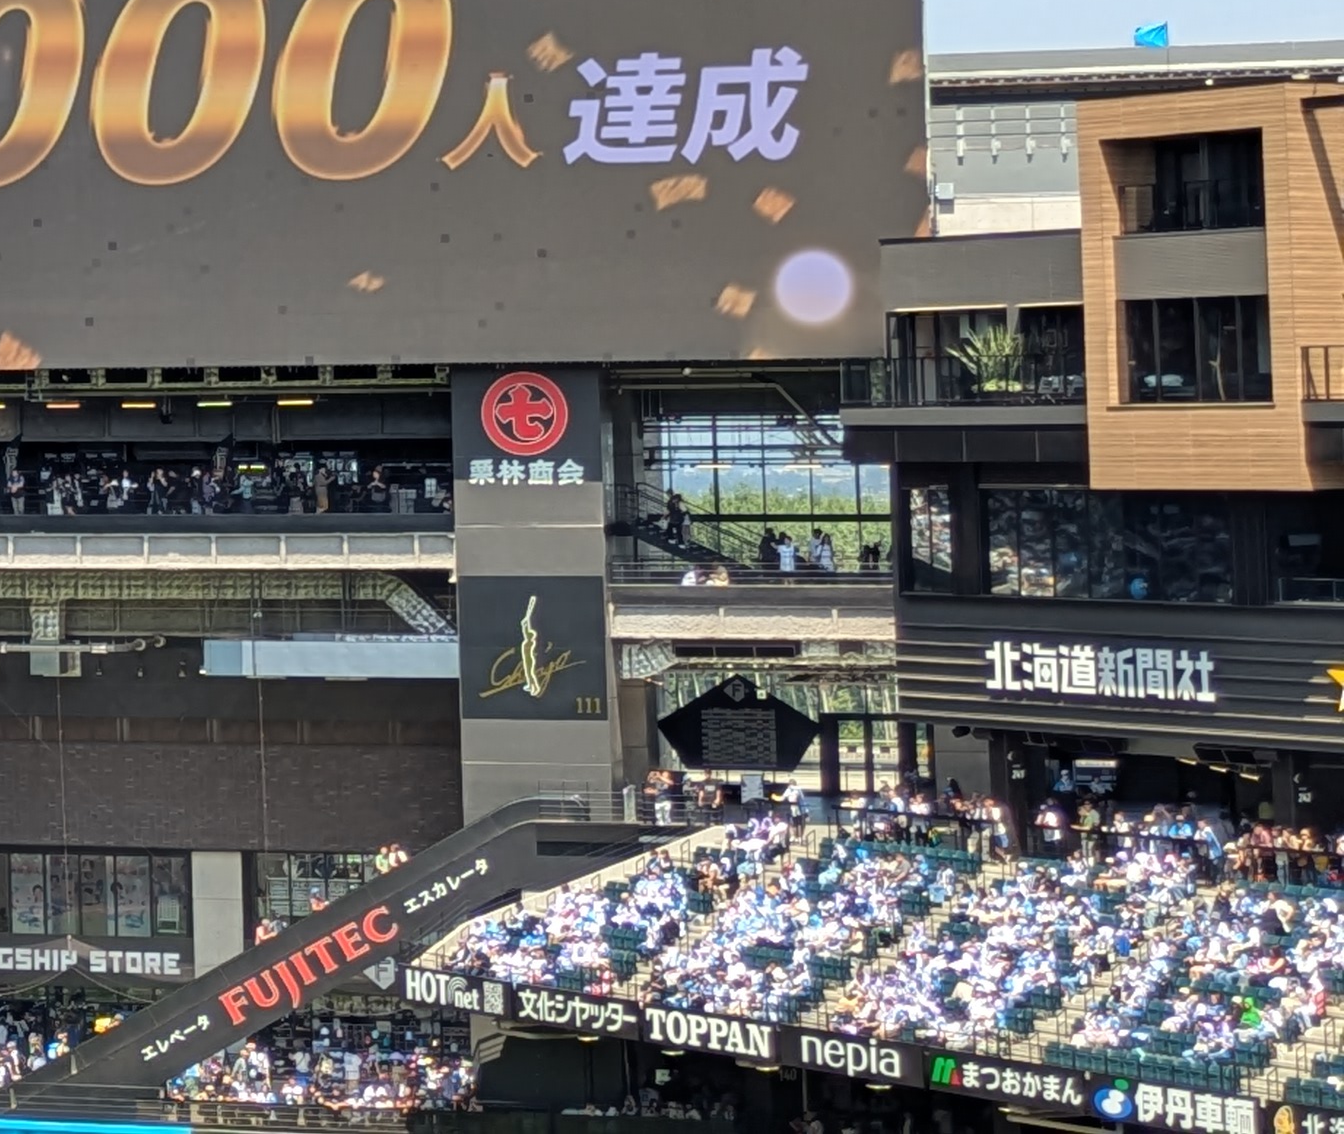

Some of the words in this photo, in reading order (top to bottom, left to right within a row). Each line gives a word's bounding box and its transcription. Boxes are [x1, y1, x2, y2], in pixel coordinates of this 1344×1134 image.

[563, 46, 808, 164] 達成
[468, 459, 585, 486] 栗林商会
[984, 641, 1216, 703] 北海道新聞社
[576, 698, 601, 713] 111
[403, 858, 489, 914] エスカレータ
[89, 949, 181, 975] STORE
[218, 906, 399, 1025] FUJITEC
[141, 1013, 210, 1060] エレベータ
[645, 1007, 772, 1058] TOPPAN
[800, 1032, 901, 1078] nepia
[962, 1061, 1082, 1106] まつおかまん
[1301, 1113, 1344, 1134] 北
